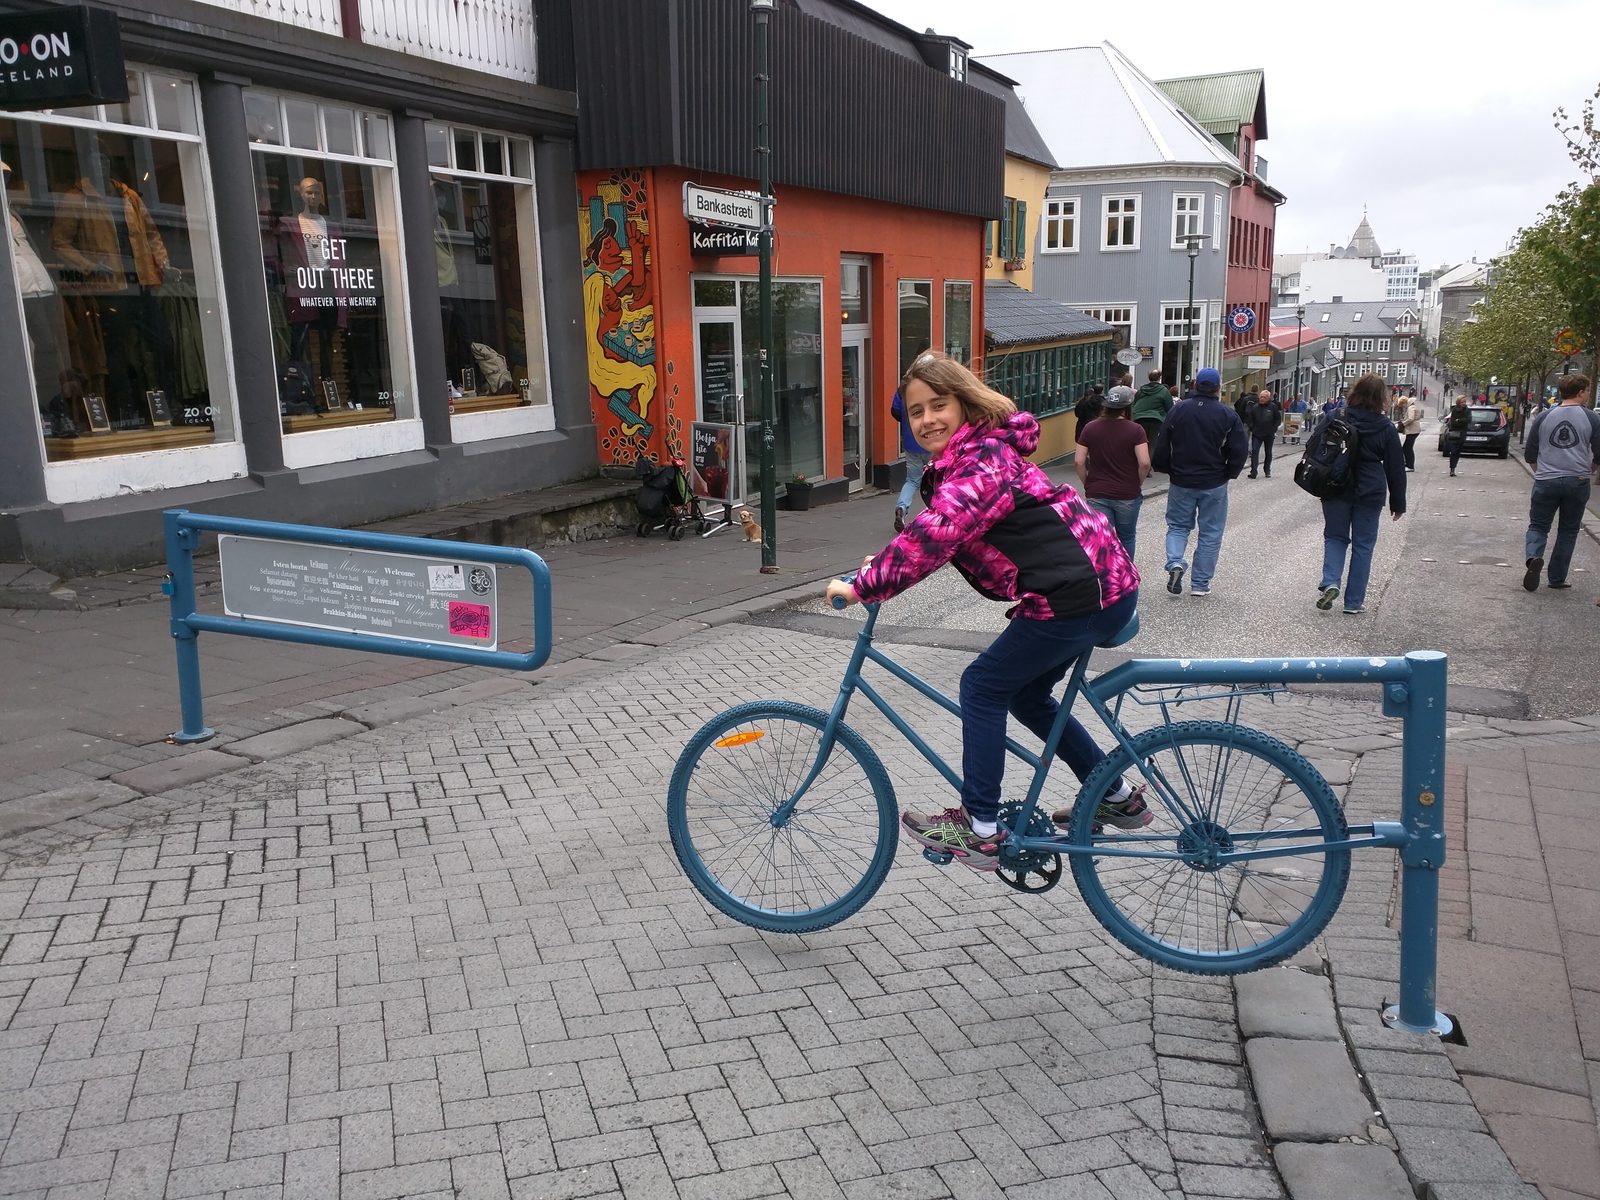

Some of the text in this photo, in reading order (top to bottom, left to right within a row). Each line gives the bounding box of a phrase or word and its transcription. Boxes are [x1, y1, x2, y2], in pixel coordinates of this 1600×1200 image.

[697, 195, 753, 219] Bankastræti
[321, 239, 347, 260] GET
[693, 231, 745, 249] Kaffitár
[297, 267, 375, 289] OUT THERE
[299, 297, 377, 307] WHATEVER THE WEATHER
[384, 567, 416, 578] Welcome
